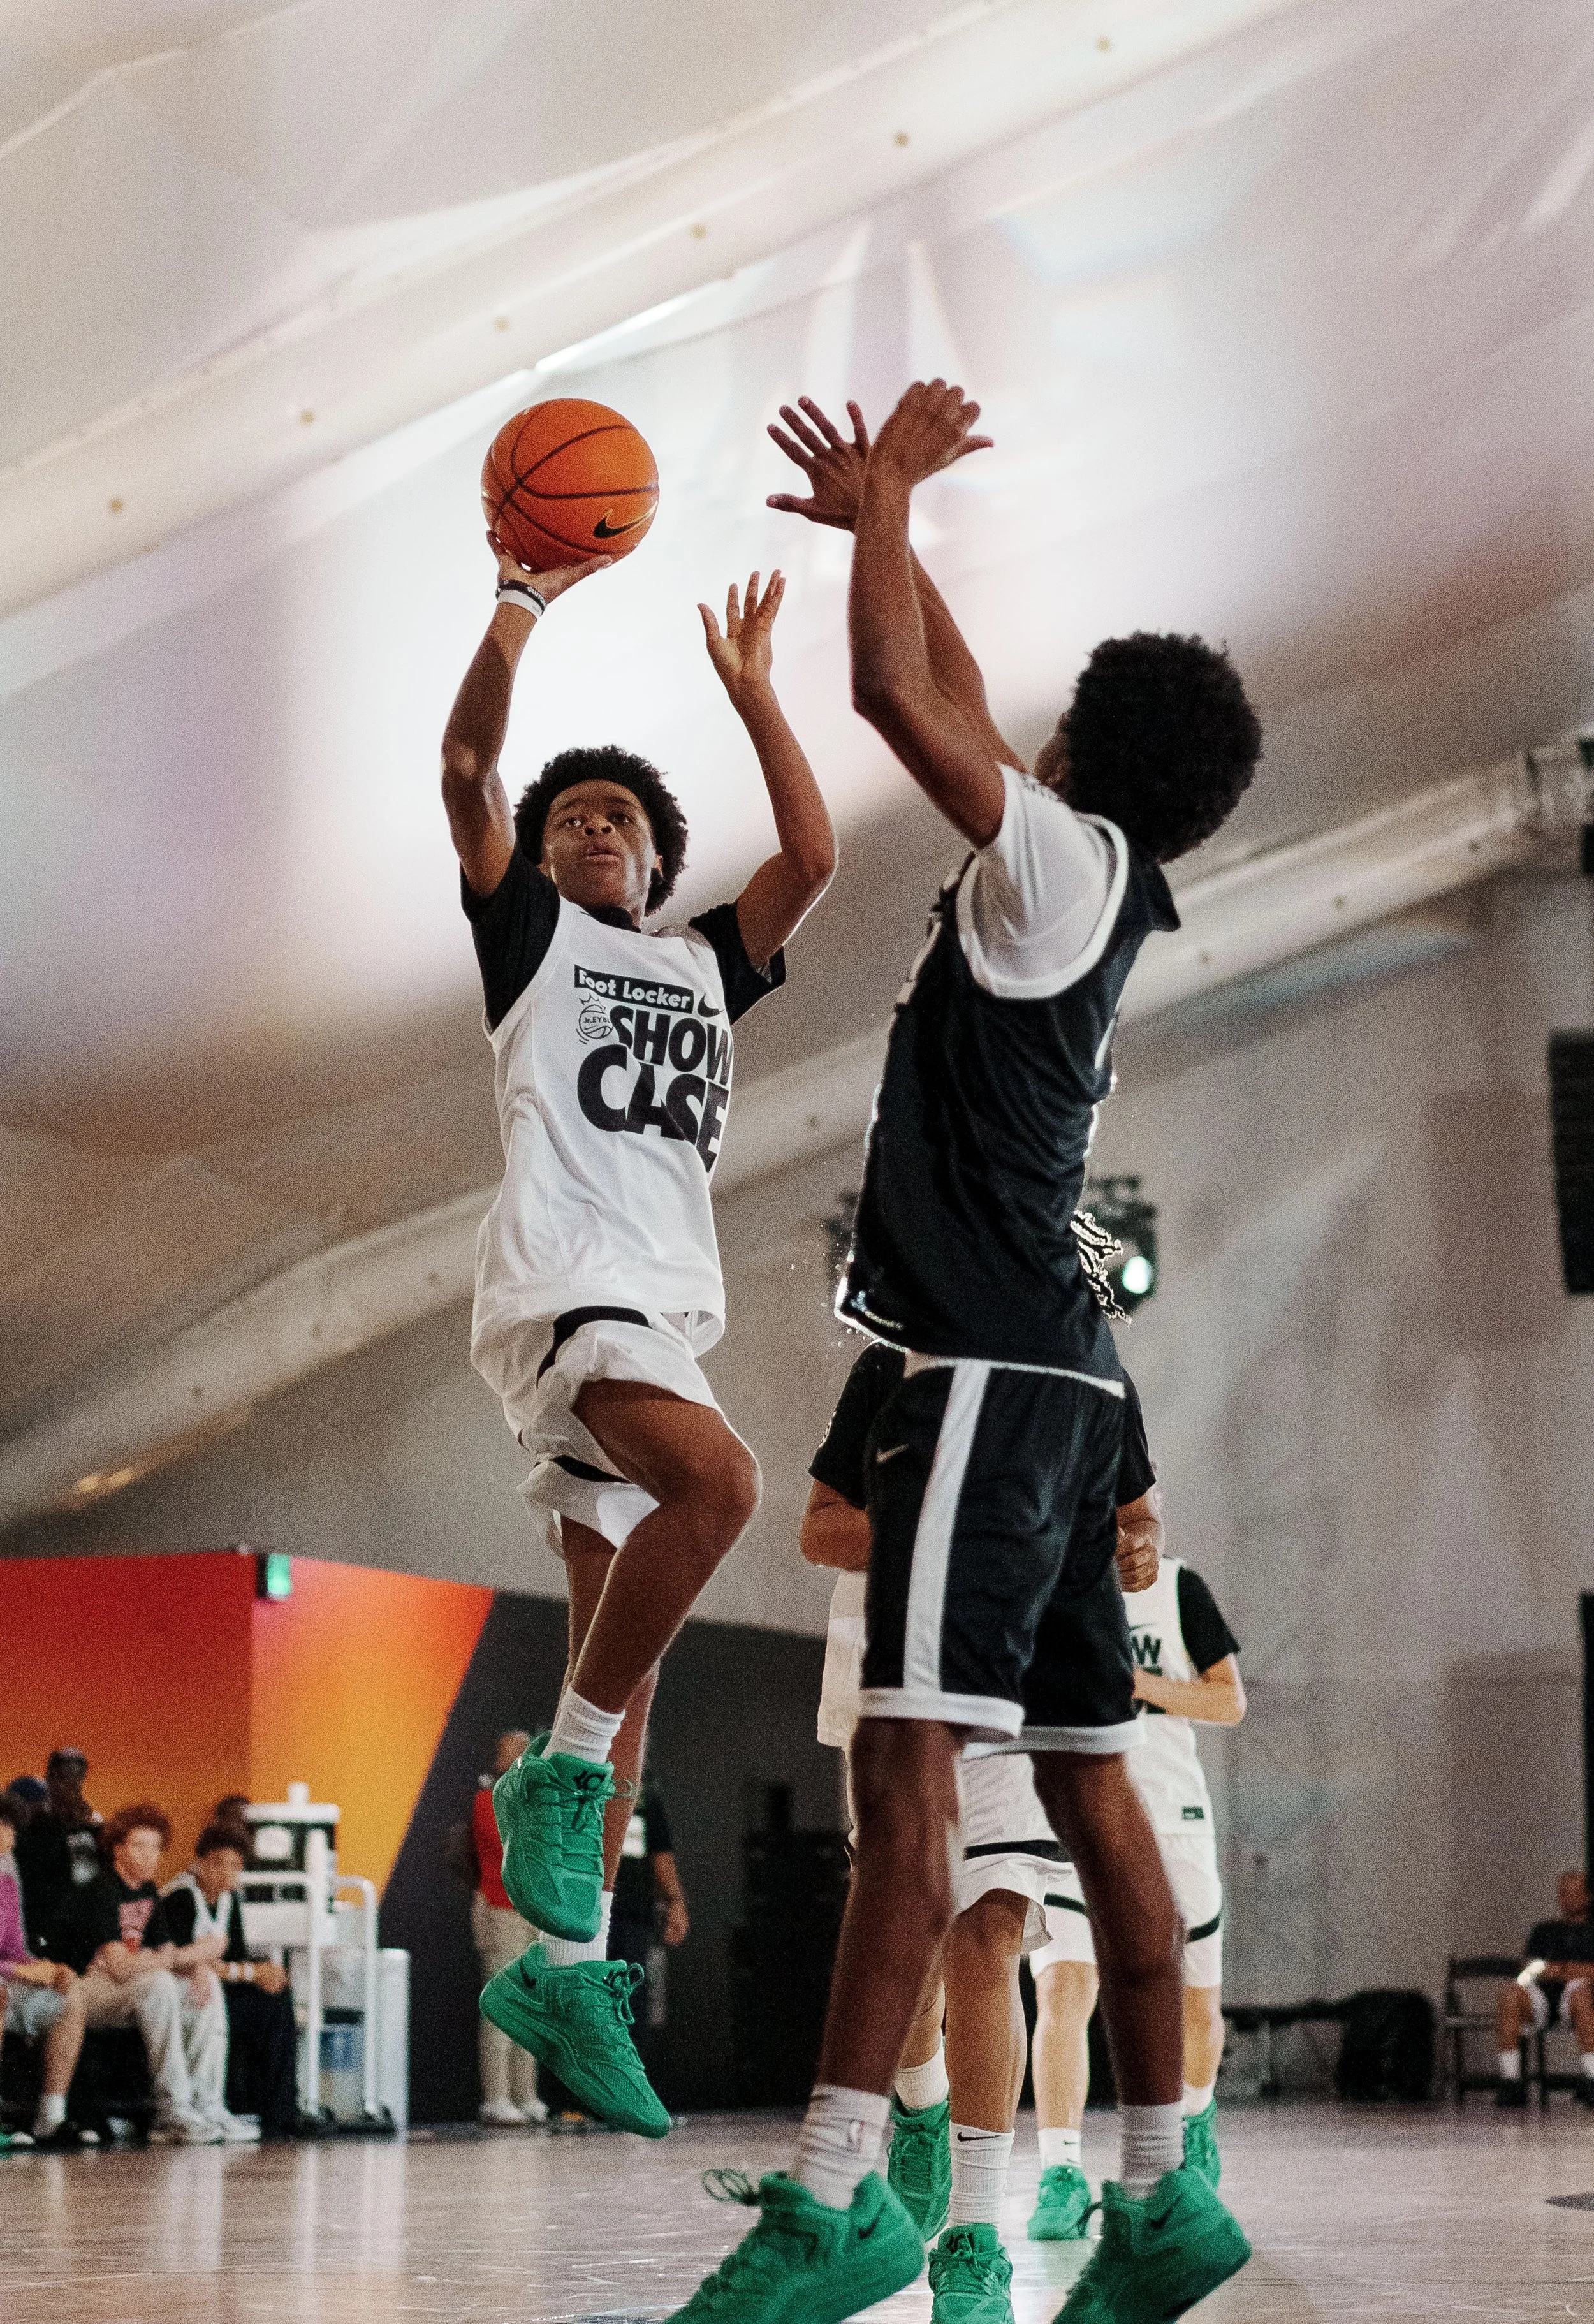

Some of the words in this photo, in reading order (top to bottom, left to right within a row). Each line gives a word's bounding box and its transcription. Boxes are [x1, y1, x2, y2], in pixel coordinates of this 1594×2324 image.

[578, 970, 616, 996] Foot
[623, 981, 691, 1009] Locker
[610, 1005, 733, 1086] SHOW
[577, 1044, 729, 1173] CASE
